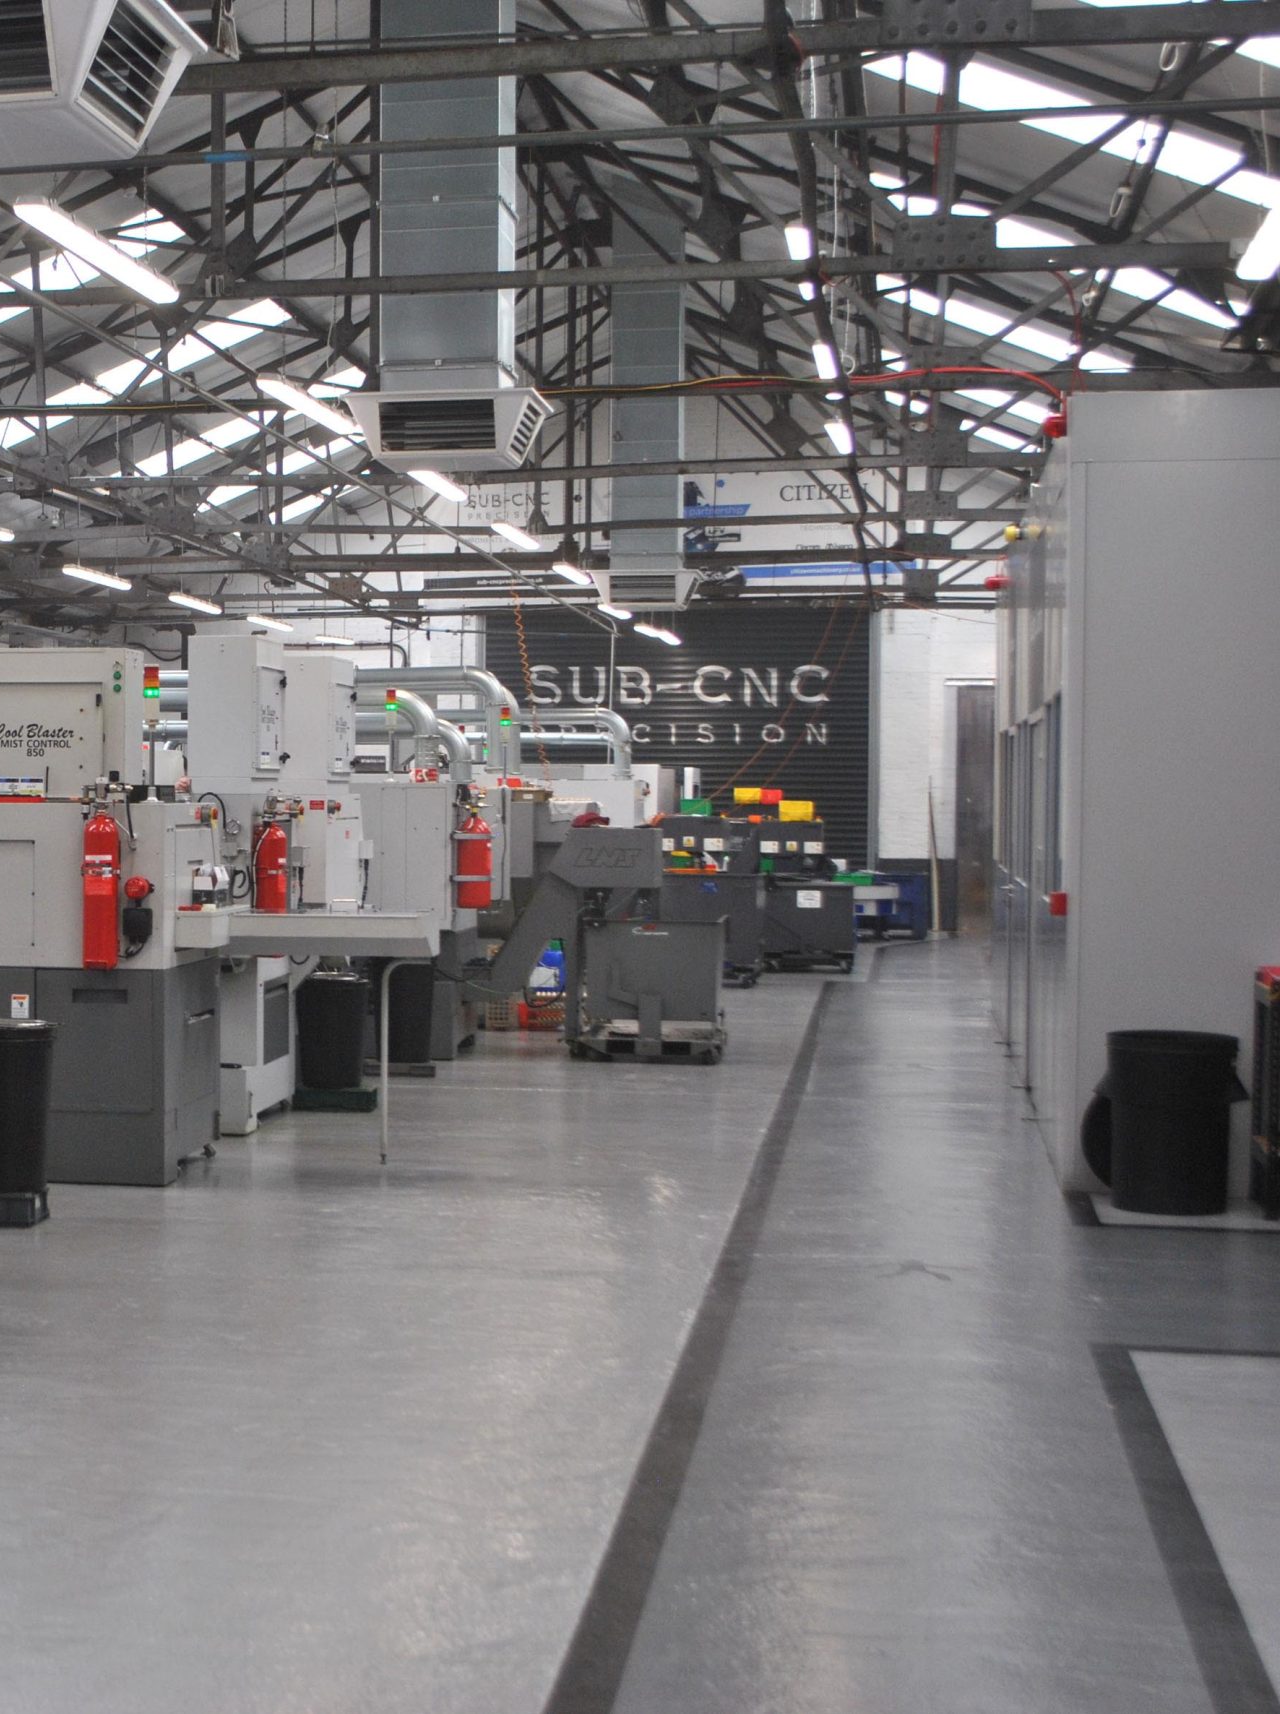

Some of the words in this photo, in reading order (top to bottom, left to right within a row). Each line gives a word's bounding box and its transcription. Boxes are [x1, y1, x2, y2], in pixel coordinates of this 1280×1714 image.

[525, 664, 830, 707] SUB-CNC
[26, 723, 74, 738] Blaster
[530, 722, 827, 745] CISION
[0, 740, 23, 748] MIST
[26, 740, 72, 748] CONTROL
[26, 748, 45, 757] 850
